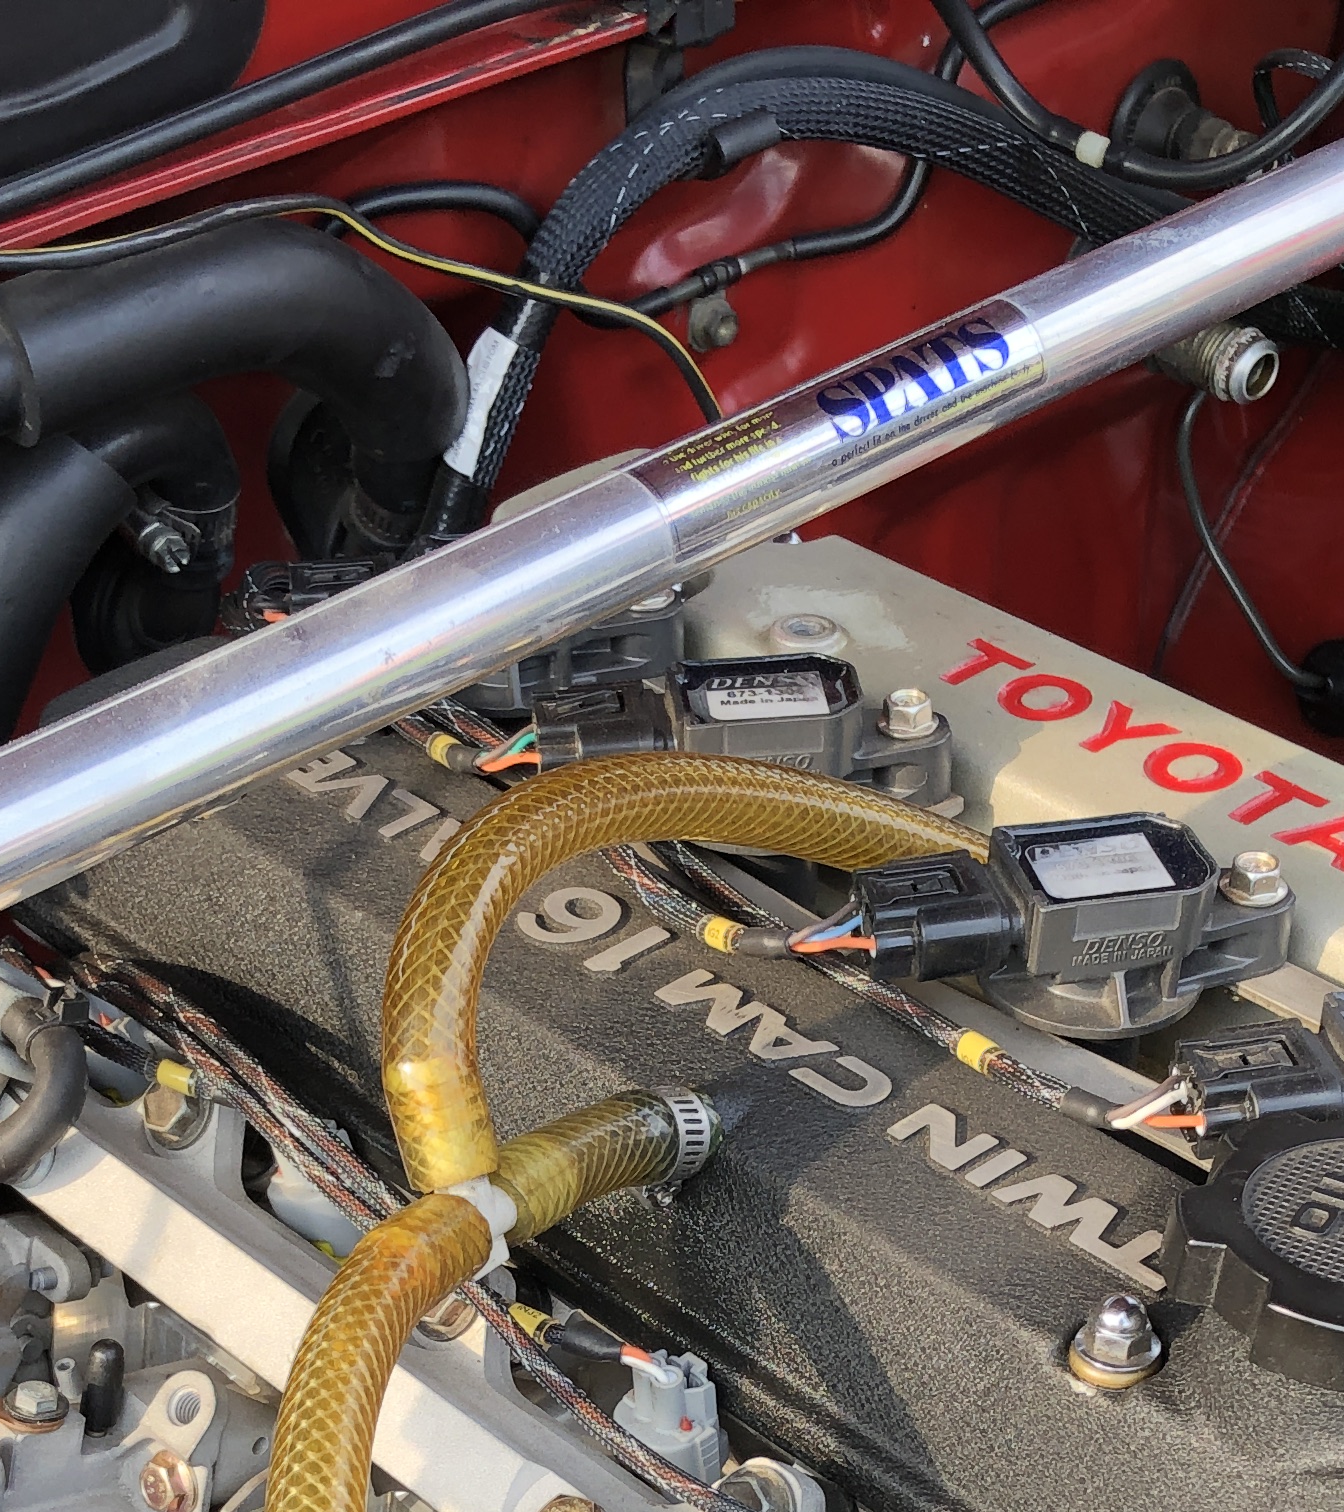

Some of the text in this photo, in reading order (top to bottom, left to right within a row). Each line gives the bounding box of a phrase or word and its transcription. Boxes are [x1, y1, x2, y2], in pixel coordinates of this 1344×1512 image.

[816, 317, 1009, 443] SPATS
[914, 408, 939, 426] driver
[711, 672, 809, 689] DEN
[720, 697, 756, 706] Made
[761, 696, 773, 704] in
[1082, 931, 1164, 954] DENSO
[1071, 945, 1172, 967] MADE IN JAPAN
[286, 750, 1168, 1292] TWIN CAM 16 LVE
[516, 1304, 542, 1319] INJ2
